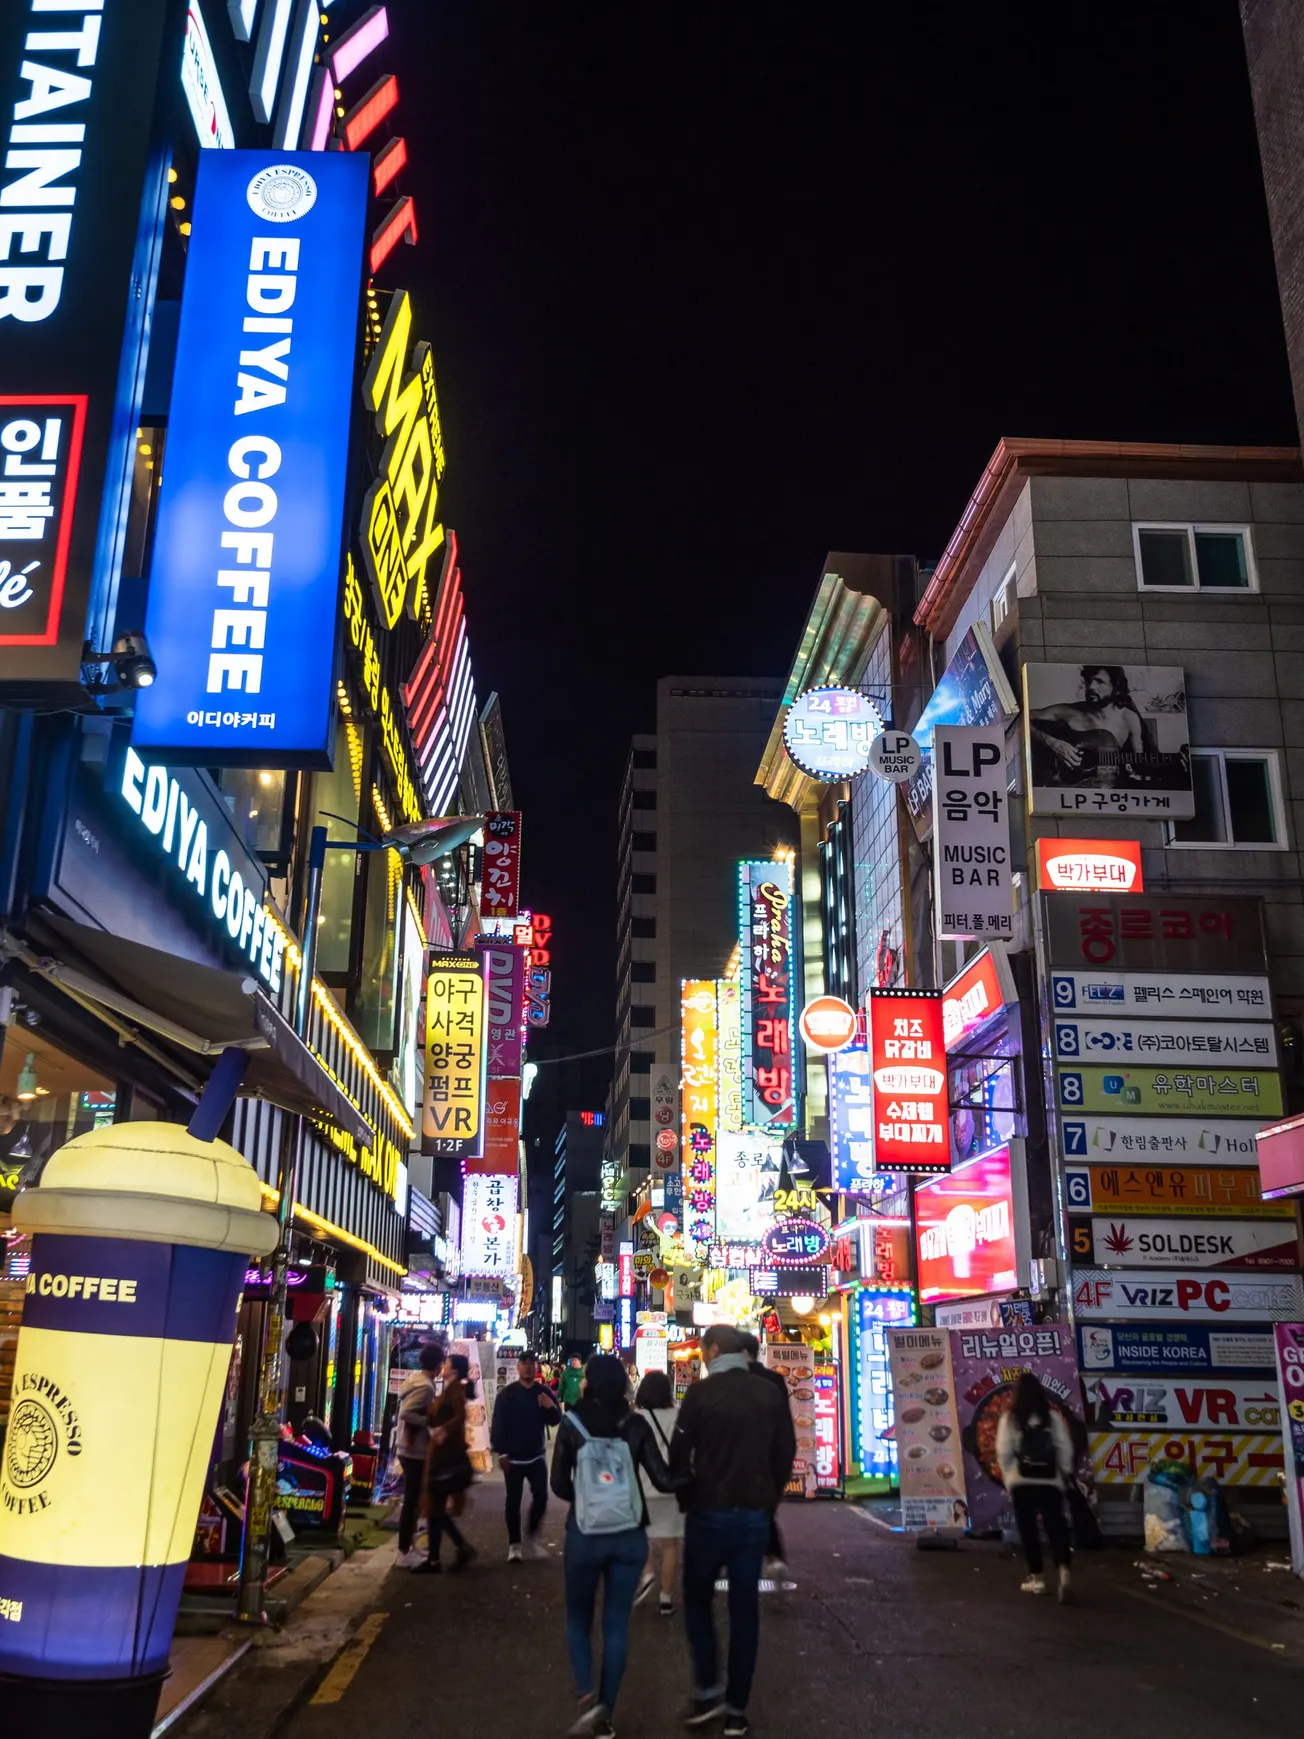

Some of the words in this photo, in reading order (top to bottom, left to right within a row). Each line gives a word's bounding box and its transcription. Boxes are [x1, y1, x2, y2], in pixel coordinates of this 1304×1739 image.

[0, 0, 104, 323] TAINER
[237, 237, 300, 415] EDIYA
[422, 350, 446, 481] EXTREME
[372, 290, 444, 620] MAX
[206, 435, 282, 693] COFFEE
[808, 696, 831, 713] 24
[972, 680, 992, 713] Mary
[187, 710, 276, 729] 이디야커피
[791, 718, 878, 757] 노래방
[882, 737, 910, 755] LP
[879, 756, 915, 765] MUSIC
[884, 765, 909, 773] BAR
[943, 742, 1001, 777] LP
[908, 788, 920, 817] LP
[942, 789, 1003, 823] 음악
[1061, 793, 1087, 809] LP
[1091, 792, 1170, 812] 구멍가게
[944, 845, 1006, 864] MUSIC
[121, 746, 208, 896] EDIYA
[211, 849, 284, 993] COFFEE
[952, 867, 1000, 886] BAR
[1057, 863, 1126, 883] 박가부대
[761, 881, 789, 964] Praha
[944, 913, 1012, 931] 피터.폴.메리
[532, 913, 552, 967] DVD
[432, 960, 456, 968] MAX
[433, 978, 477, 1004] 야구
[489, 950, 514, 1026] DVD
[1056, 981, 1073, 1004] 9
[1133, 986, 1175, 1003] 펠리스
[1179, 987, 1233, 1005] 스페인어
[1237, 989, 1265, 1005] 학원
[431, 1010, 475, 1037] 사격
[893, 1018, 924, 1037] 치즈
[757, 973, 790, 1104] 노래방
[884, 1039, 932, 1060] 닭갈비
[1060, 1029, 1077, 1052] 8
[1085, 1031, 1132, 1050] CORE
[431, 1042, 475, 1070] 양궁
[429, 1075, 473, 1102] 펌프
[882, 1074, 936, 1090] 박가부대
[1063, 1077, 1081, 1101] 8
[1152, 1074, 1260, 1097] 유학마스터
[430, 1106, 472, 1131] VR
[886, 1101, 935, 1121] 수제햄
[878, 1123, 943, 1144] 부대찌개
[1066, 1127, 1083, 1150] 7
[1120, 1135, 1188, 1152] 한림출판사
[658, 1153, 671, 1161] 4F
[734, 1150, 763, 1169] 종로
[693, 1137, 711, 1210] 노래방
[1069, 1178, 1087, 1201] 6
[1100, 1170, 1188, 1197] 에스앤유
[486, 1180, 505, 1212] 곱창
[602, 1177, 614, 1200] PC
[773, 1190, 816, 1210] 24시
[483, 1236, 501, 1267] 본가
[771, 1235, 821, 1253] 노래방
[876, 1224, 895, 1281] 노래방
[1074, 1228, 1090, 1253] 5
[1138, 1233, 1235, 1255] SOLDESK
[39, 1273, 138, 1303] COFFEE
[1075, 1281, 1112, 1308] 4F
[1176, 1279, 1231, 1311] PC
[863, 1302, 884, 1318] 24
[894, 1334, 943, 1349] 별미메뉴
[961, 1331, 1062, 1359] 리뉴얼오픈!
[1117, 1346, 1159, 1358] INSIDE
[1163, 1346, 1207, 1359] KOREA
[773, 1350, 808, 1361] 특별메뉴
[22, 1372, 83, 1456] ESPRESSO
[1173, 1387, 1240, 1425] VR
[1103, 1440, 1150, 1476] 4F
[275, 1496, 325, 1512] ESPERADO
